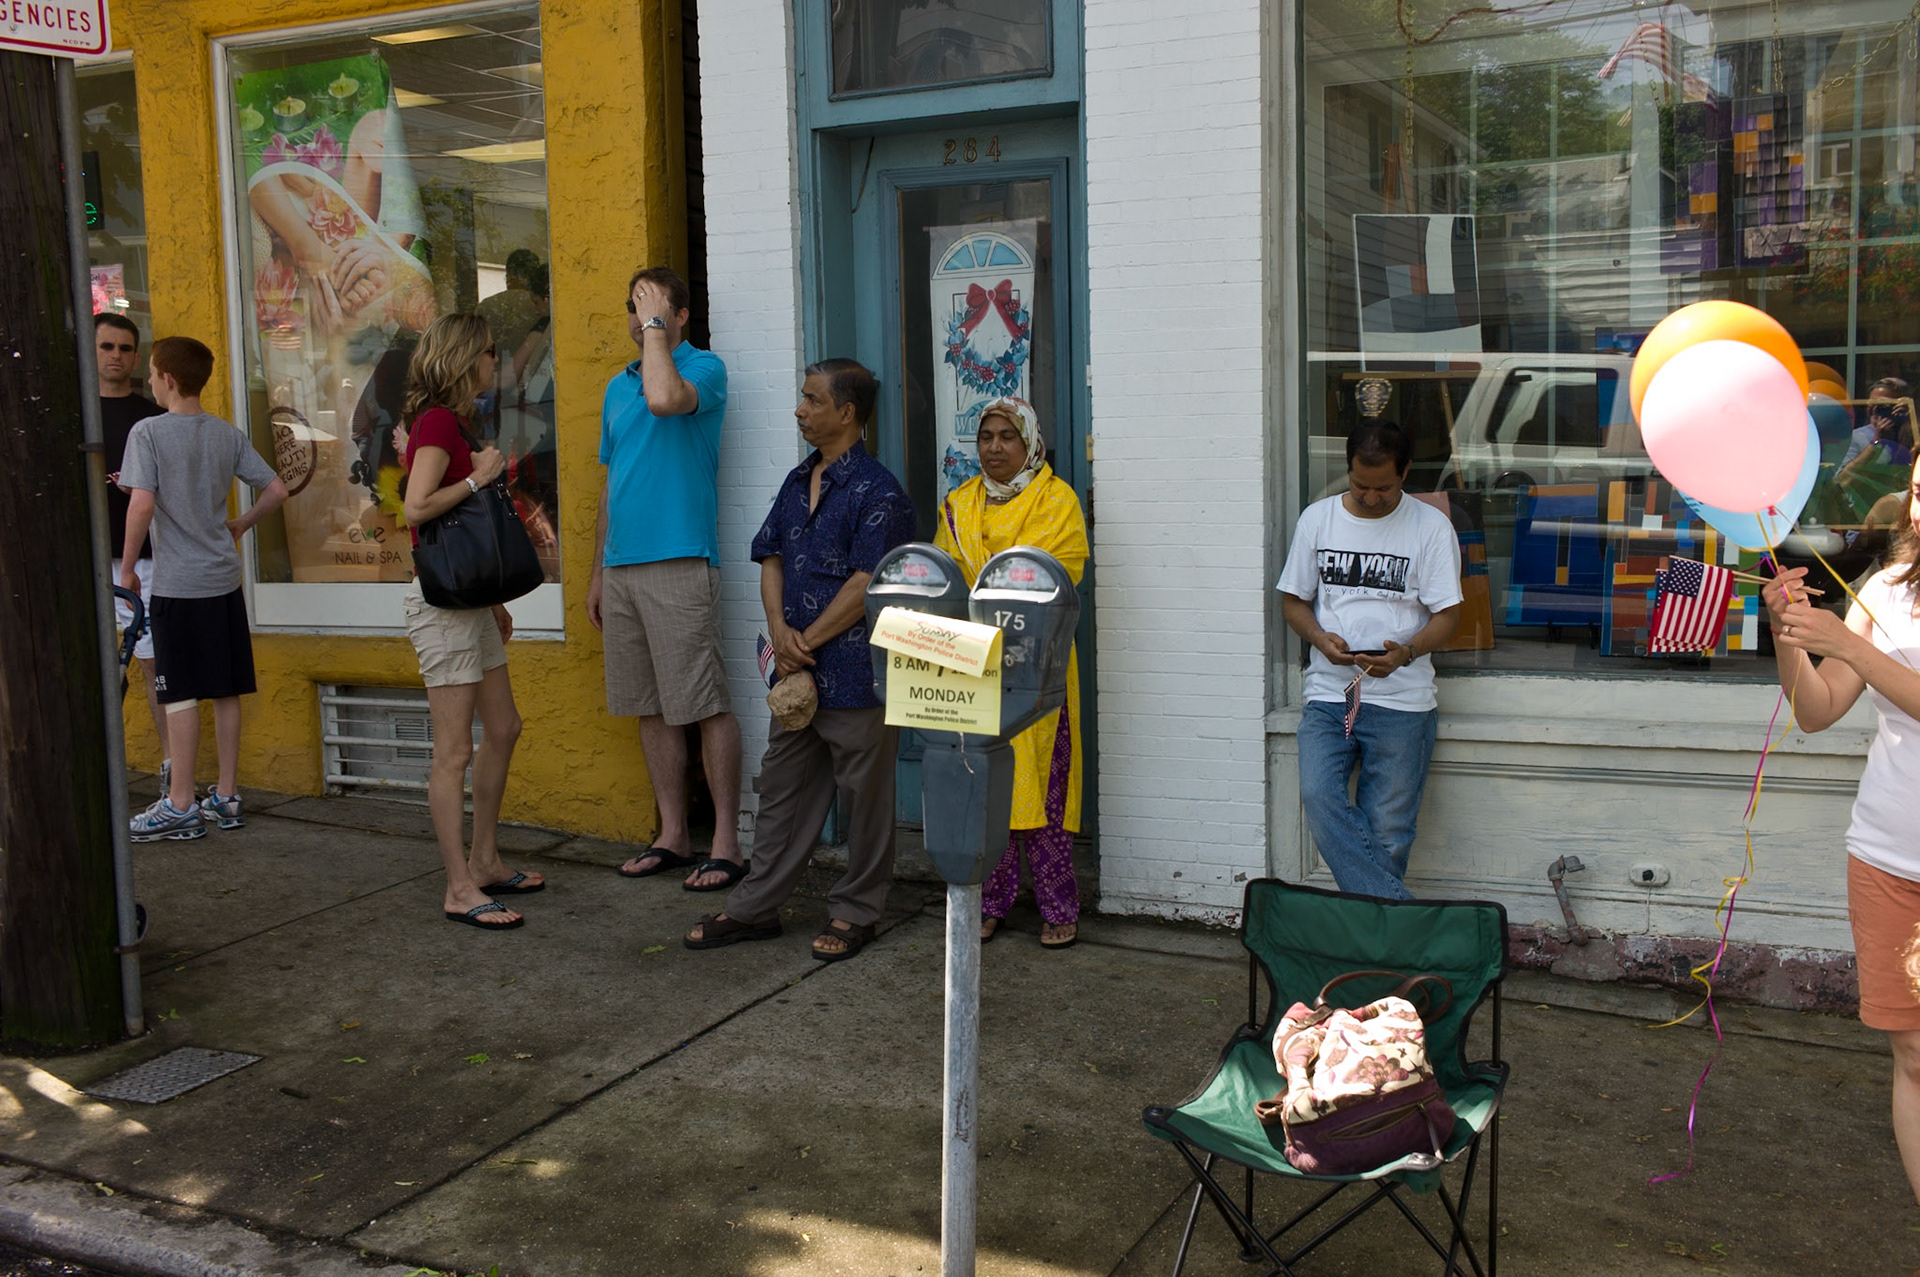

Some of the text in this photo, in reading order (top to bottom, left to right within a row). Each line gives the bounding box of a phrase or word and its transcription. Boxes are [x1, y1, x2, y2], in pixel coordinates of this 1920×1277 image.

[943, 136, 1001, 165] 284
[335, 551, 402, 565] NAIL & SPA
[995, 610, 1025, 631] 175
[881, 630, 978, 666] Port Washington Police District
[908, 630, 916, 639] By
[918, 633, 935, 643] Order
[945, 642, 955, 650] the
[894, 656, 902, 669] 8
[905, 656, 930, 671] AM
[909, 686, 975, 705] MONDAY
